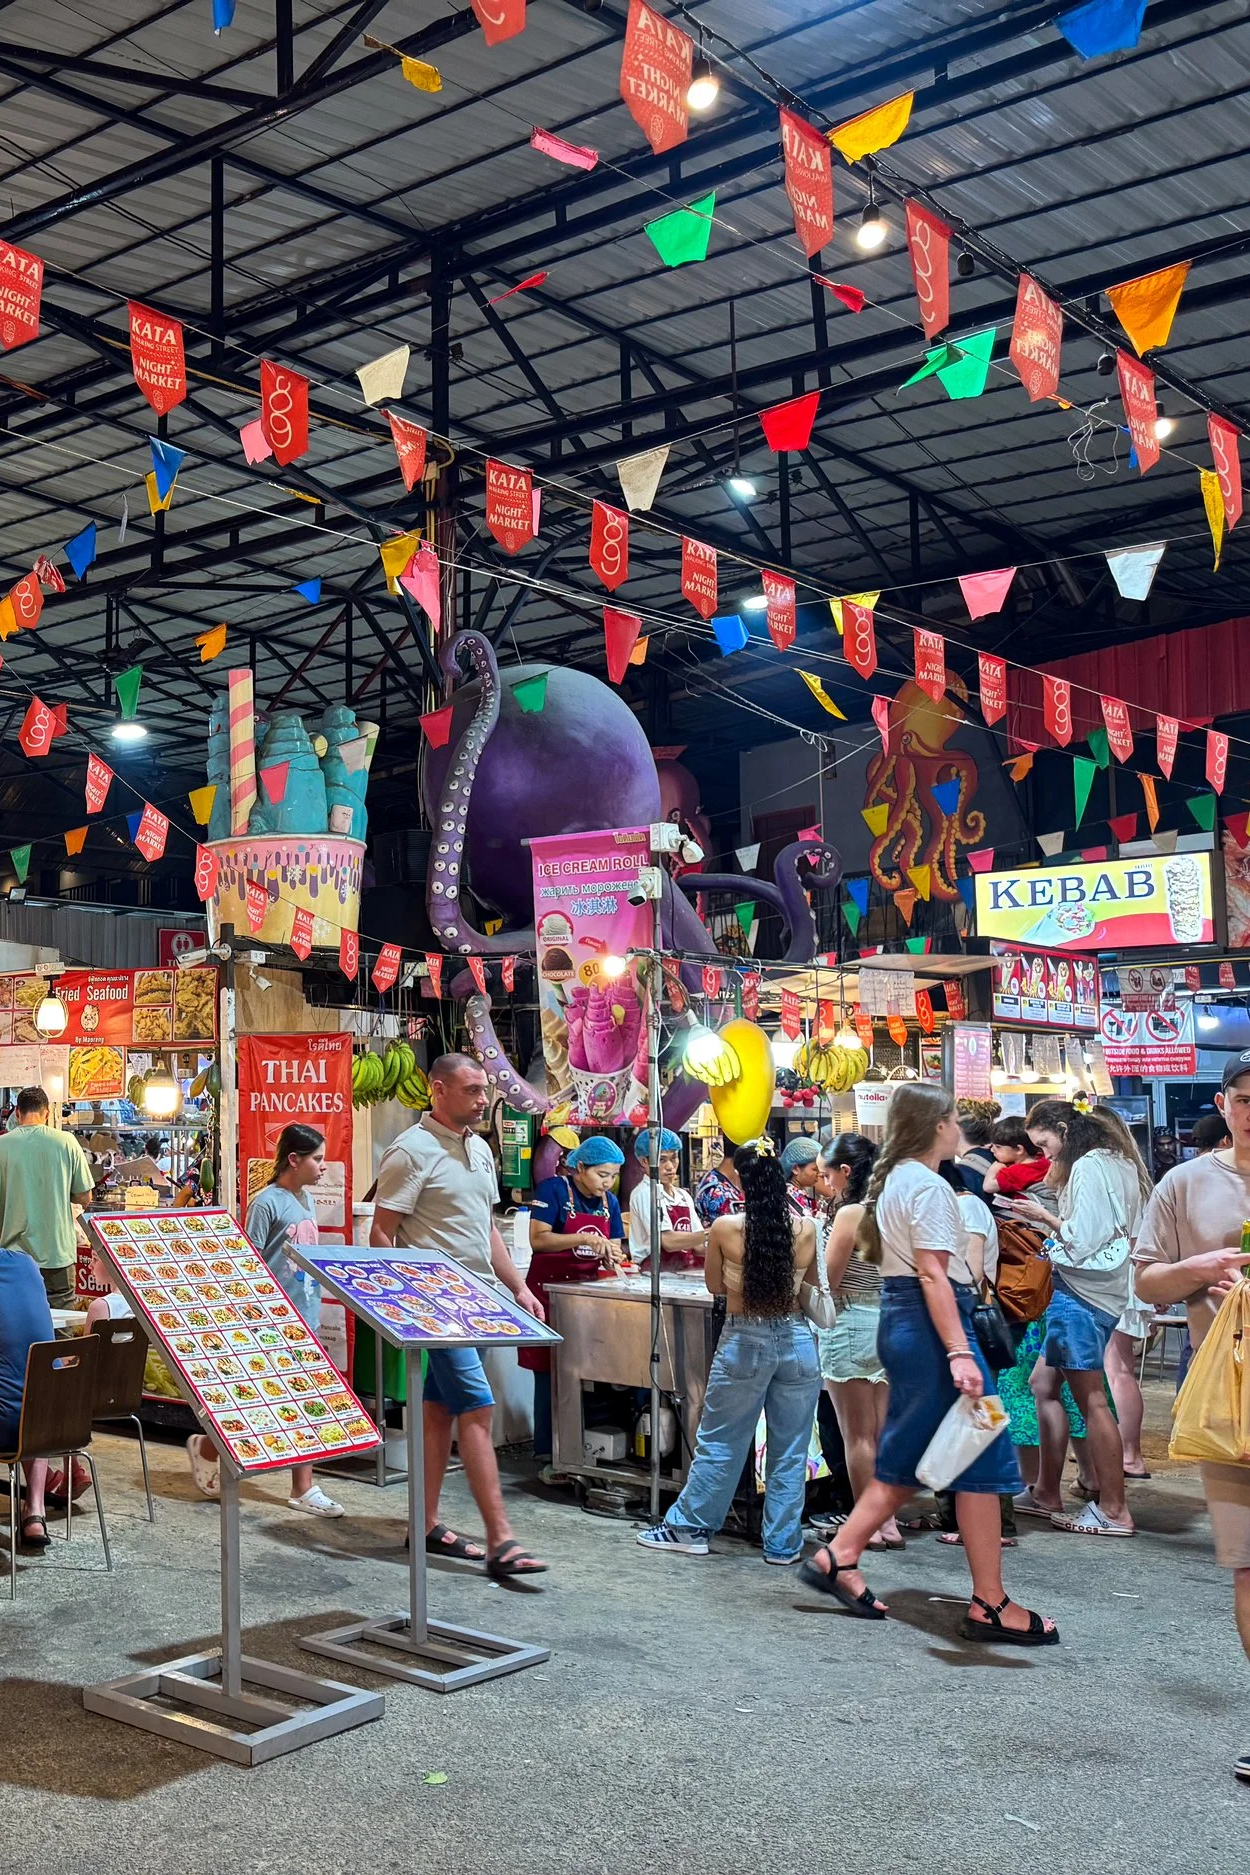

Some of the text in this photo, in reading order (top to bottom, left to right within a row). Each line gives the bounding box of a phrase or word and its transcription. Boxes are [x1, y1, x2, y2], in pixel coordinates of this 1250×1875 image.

[18, 273, 39, 290] STREET
[131, 315, 177, 345] KATA
[155, 341, 179, 354] STREET
[139, 355, 173, 374] NIGHT
[134, 365, 182, 391] MARKET
[488, 470, 528, 491] KATA
[509, 489, 529, 499] STREET
[495, 502, 522, 517] NIGHT
[488, 514, 531, 531] MARKET
[687, 541, 717, 566] KATA
[919, 634, 944, 650] KATA
[88, 761, 109, 786] KATA
[144, 808, 167, 829] KATA
[137, 834, 164, 851] MARKET
[144, 829, 163, 844] NIGHT
[539, 855, 649, 877] ICE CREAM ROLL
[540, 886, 580, 899] жарить
[988, 869, 1155, 910] KEBAB
[571, 896, 618, 914] 冰淇淋
[297, 911, 314, 925] KATA
[542, 935, 570, 943] ORIGINAL
[382, 947, 400, 961] KATA
[375, 970, 396, 981] MARKET
[542, 971, 575, 979] CHOCOLATE
[55, 984, 128, 1002] Fried Seafood
[1165, 1046, 1191, 1054] ALLOWED
[261, 1059, 328, 1084] THAI
[250, 1092, 344, 1113] PANCAKES
